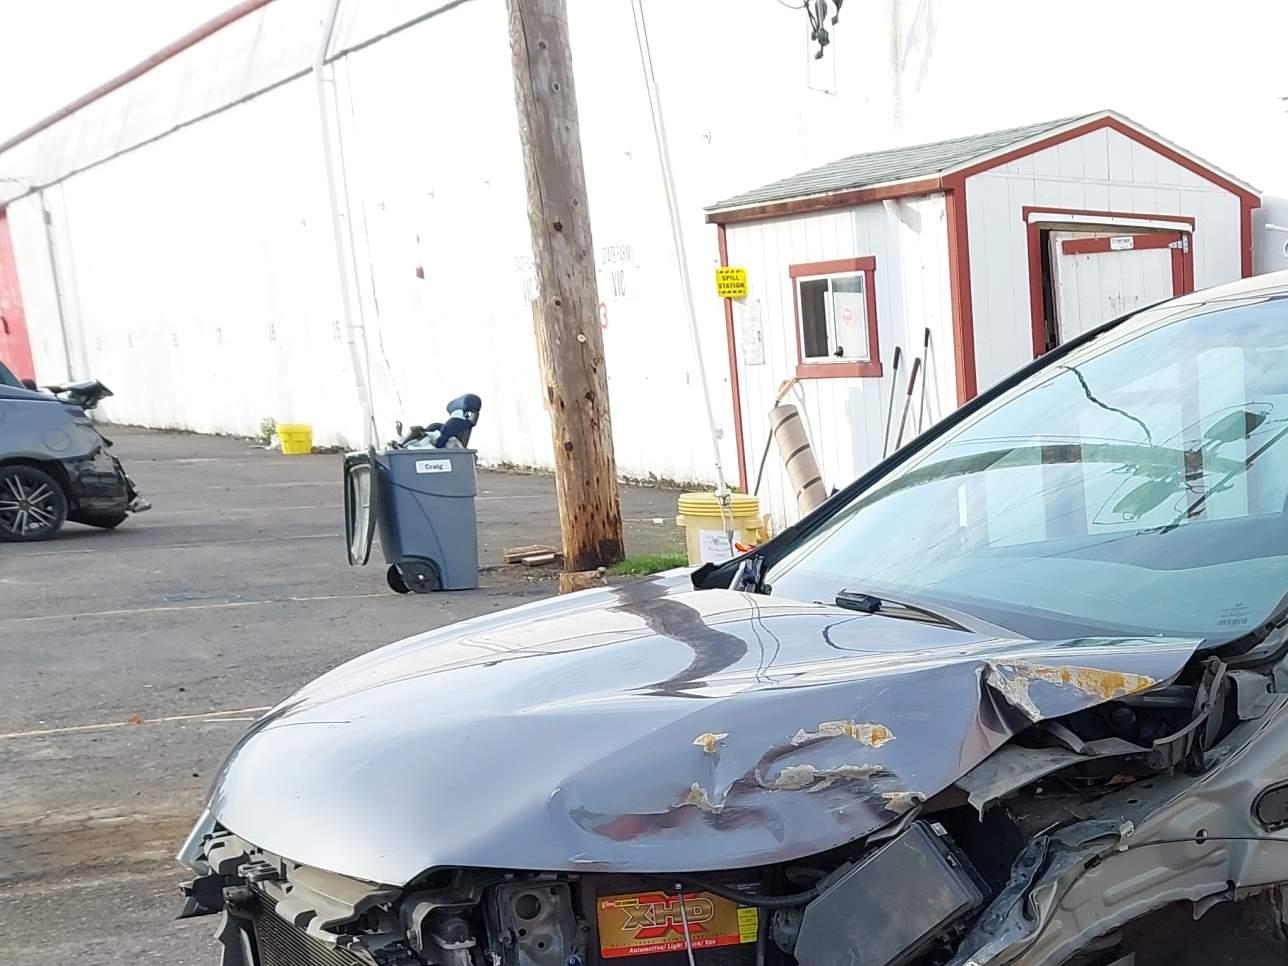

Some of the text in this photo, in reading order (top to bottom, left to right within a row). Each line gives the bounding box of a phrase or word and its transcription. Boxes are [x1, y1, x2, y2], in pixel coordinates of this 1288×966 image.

[424, 463, 444, 471] Craig
[621, 897, 714, 931] XHD
[629, 943, 666, 954] Automotive/
[667, 942, 683, 951] Light
